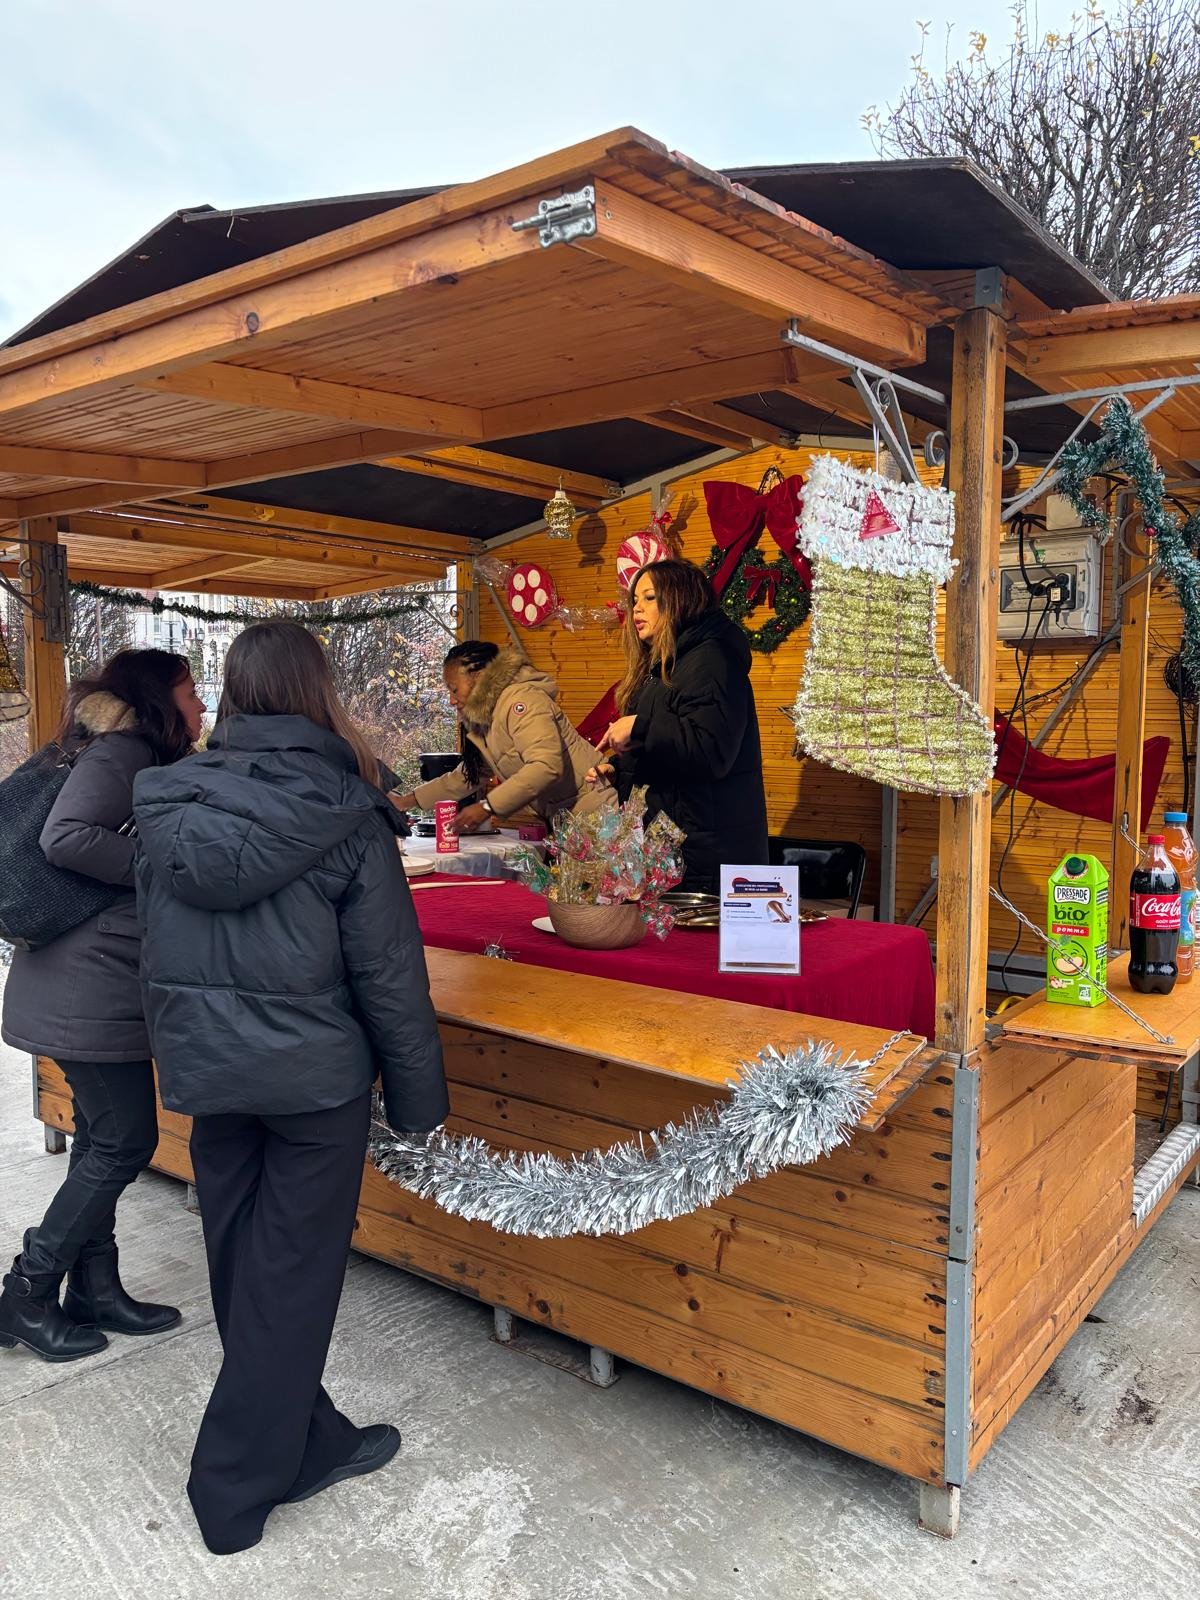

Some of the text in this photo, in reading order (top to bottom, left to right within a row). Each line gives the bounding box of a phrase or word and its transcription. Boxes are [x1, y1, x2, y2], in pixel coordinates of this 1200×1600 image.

[1057, 887, 1088, 900] PRESSADE
[1054, 905, 1090, 920] bio
[1056, 927, 1085, 935] pomme
